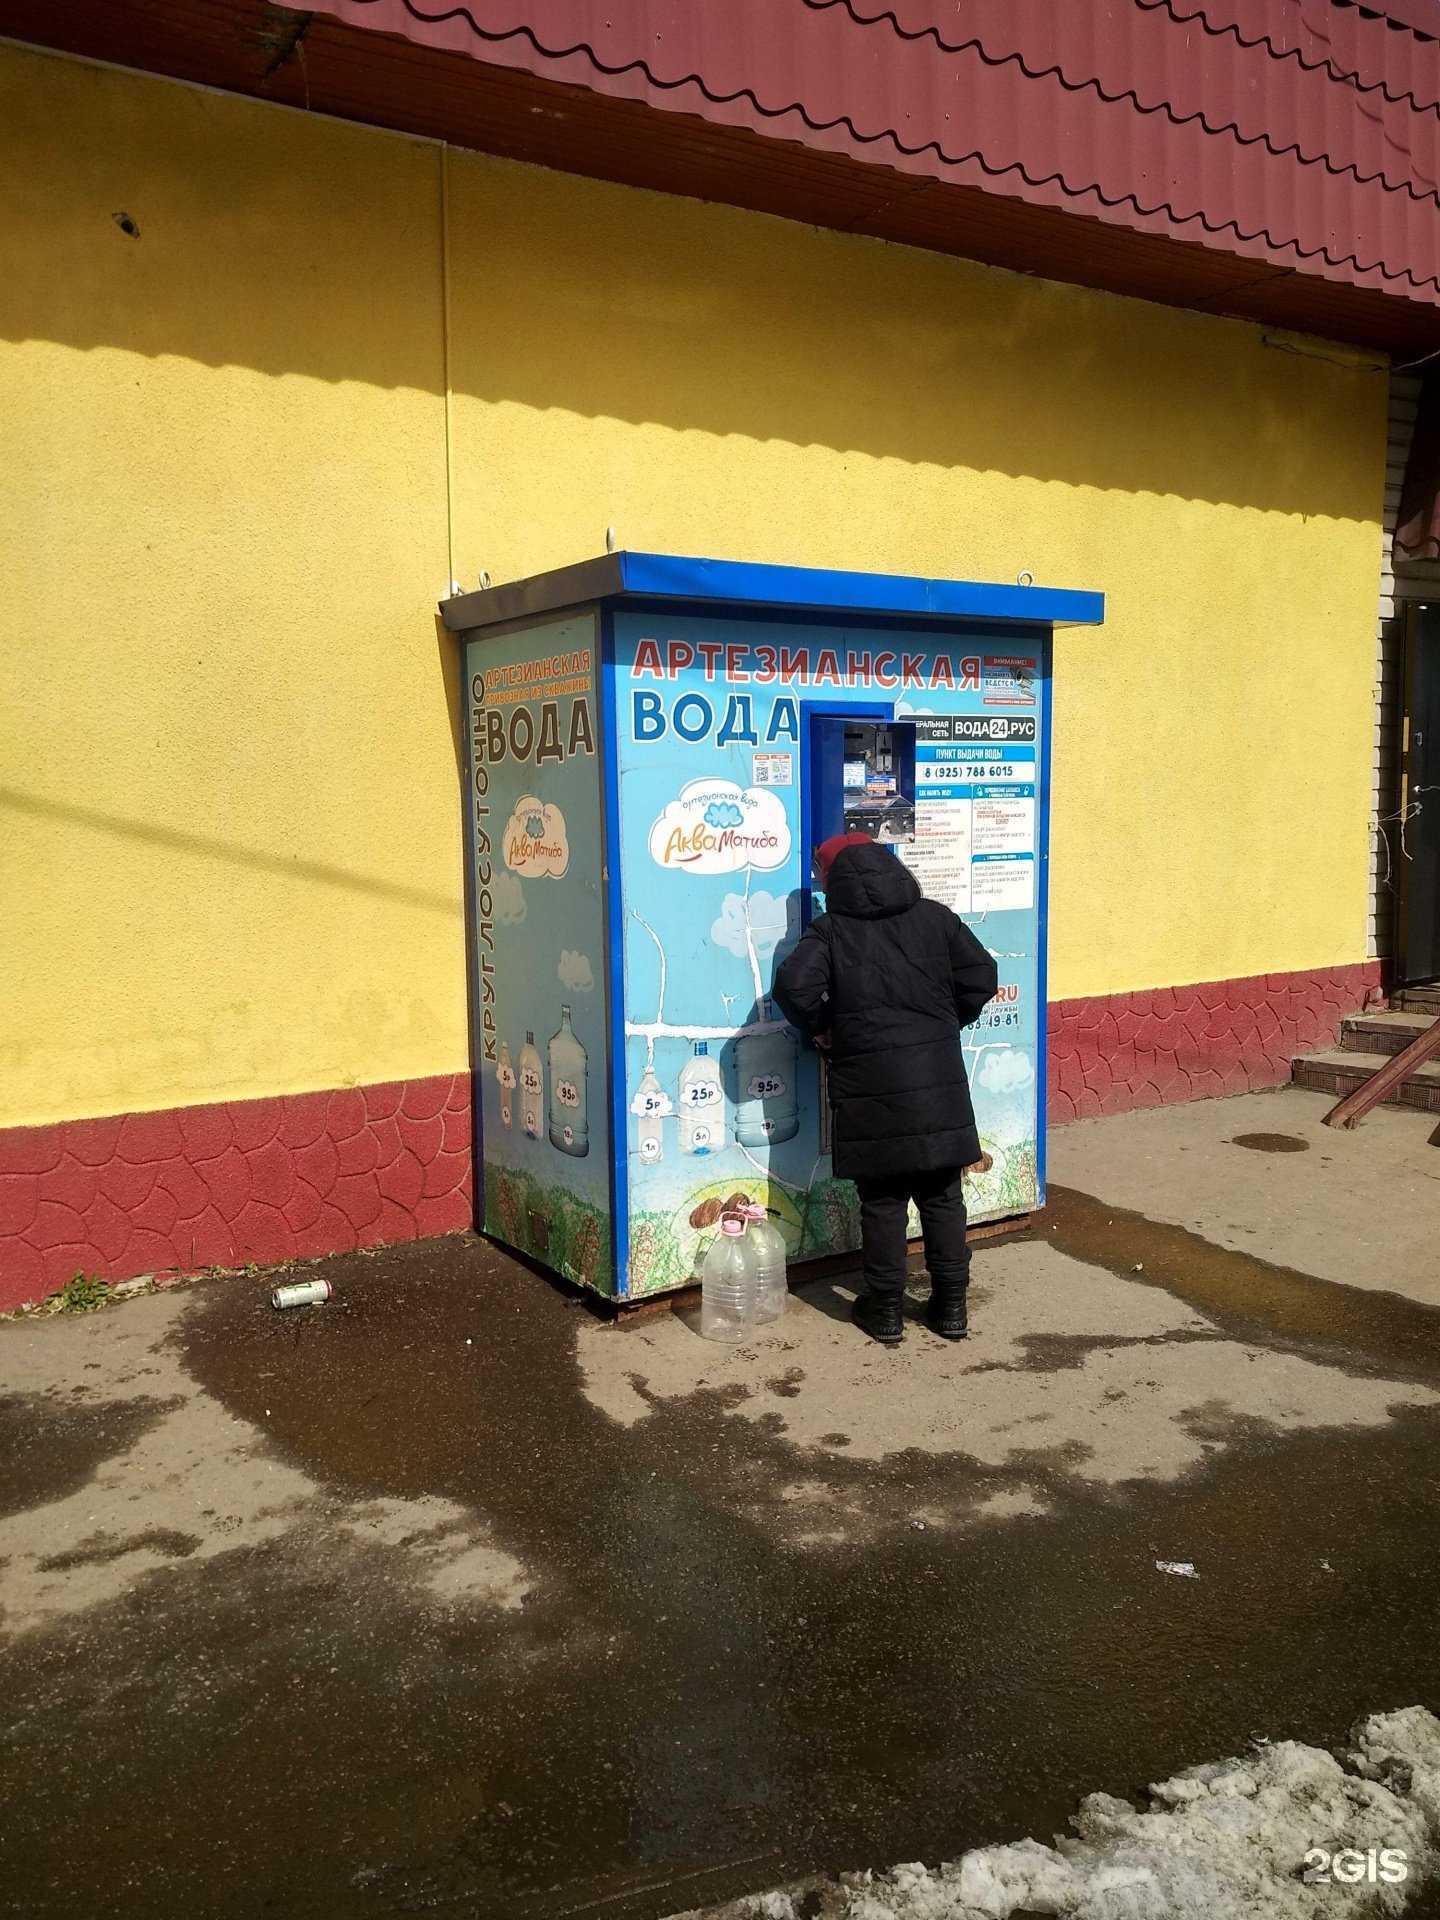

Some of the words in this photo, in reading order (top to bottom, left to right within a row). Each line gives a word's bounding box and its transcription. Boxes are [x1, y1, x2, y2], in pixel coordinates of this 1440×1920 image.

[485, 649, 591, 689] АРТЕЗИАНСКАЯ
[630, 639, 981, 691] АРТЕЗИАНСКАЯ
[486, 697, 595, 767] ВОДА
[631, 688, 799, 749] ВОДА
[916, 720, 949, 729] ЕРАЛЬНАЯ
[932, 730, 949, 738] СЕТЬ
[925, 768, 931, 778] 8
[935, 767, 963, 777] (925)
[966, 767, 985, 777] 788
[989, 766, 1013, 776] 6015
[936, 749, 956, 759] ПУНКТ
[957, 749, 984, 760] ВЫДАЧИ
[985, 749, 1003, 760] ВОДЫ
[472, 672, 498, 1063] КРУГЛОСУТОЧНО
